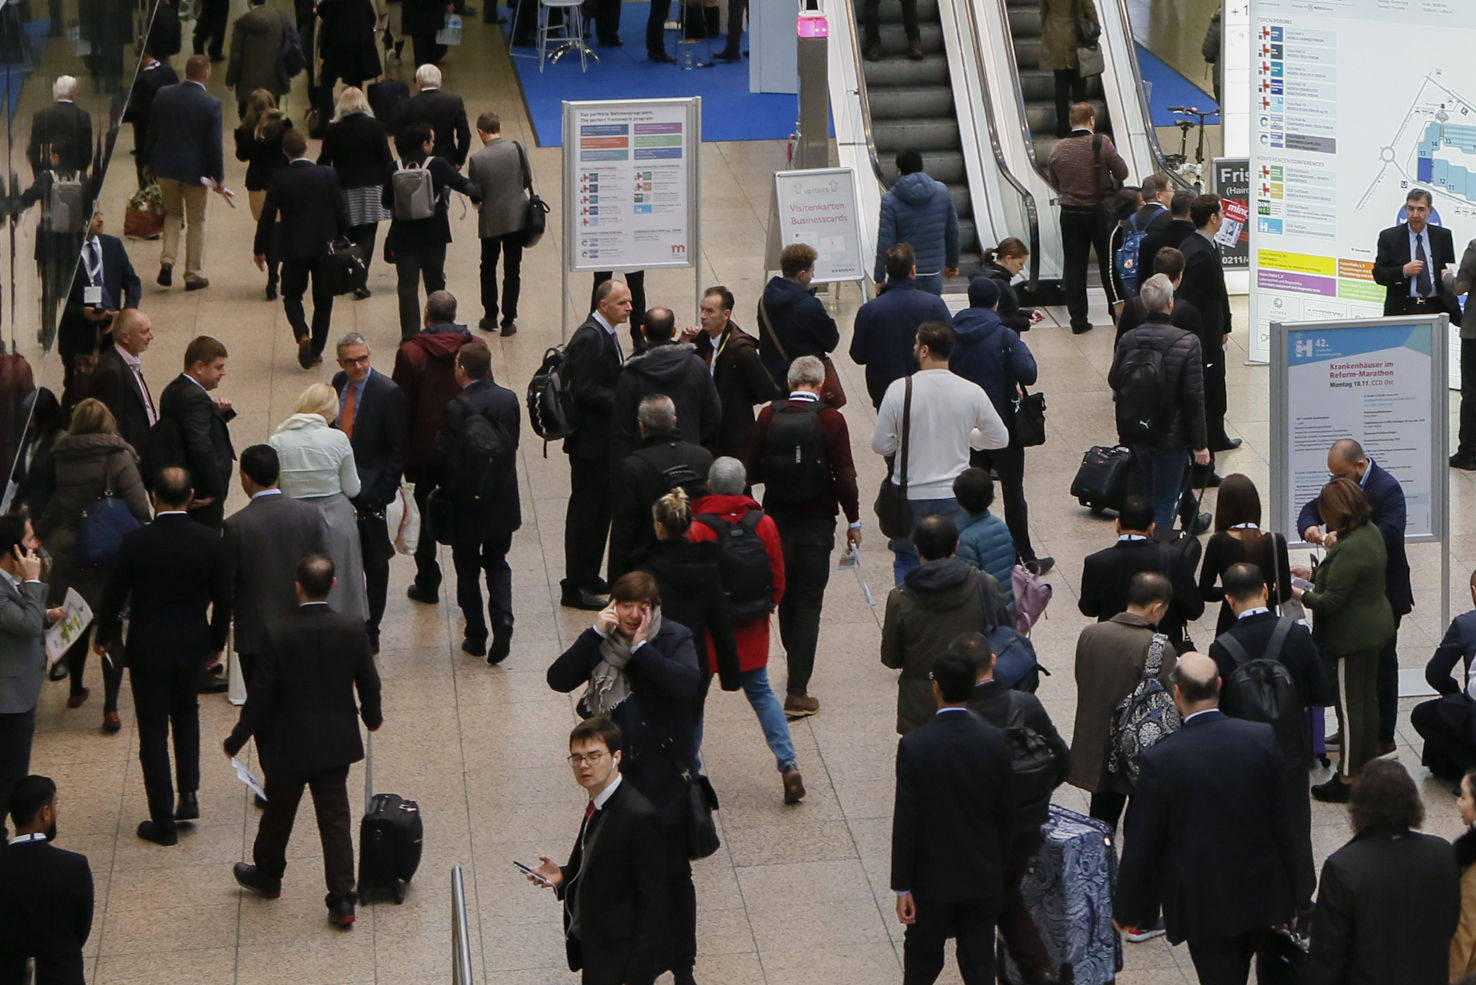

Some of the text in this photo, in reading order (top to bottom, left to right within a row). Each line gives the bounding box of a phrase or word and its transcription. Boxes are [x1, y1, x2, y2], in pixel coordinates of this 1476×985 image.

[790, 203, 845, 212] Visitenkarten
[791, 214, 848, 225] Businesscards
[1315, 339, 1328, 347] 42.
[1330, 361, 1383, 370] Krankenhäuser
[1330, 370, 1394, 378] Reform-Marathon
